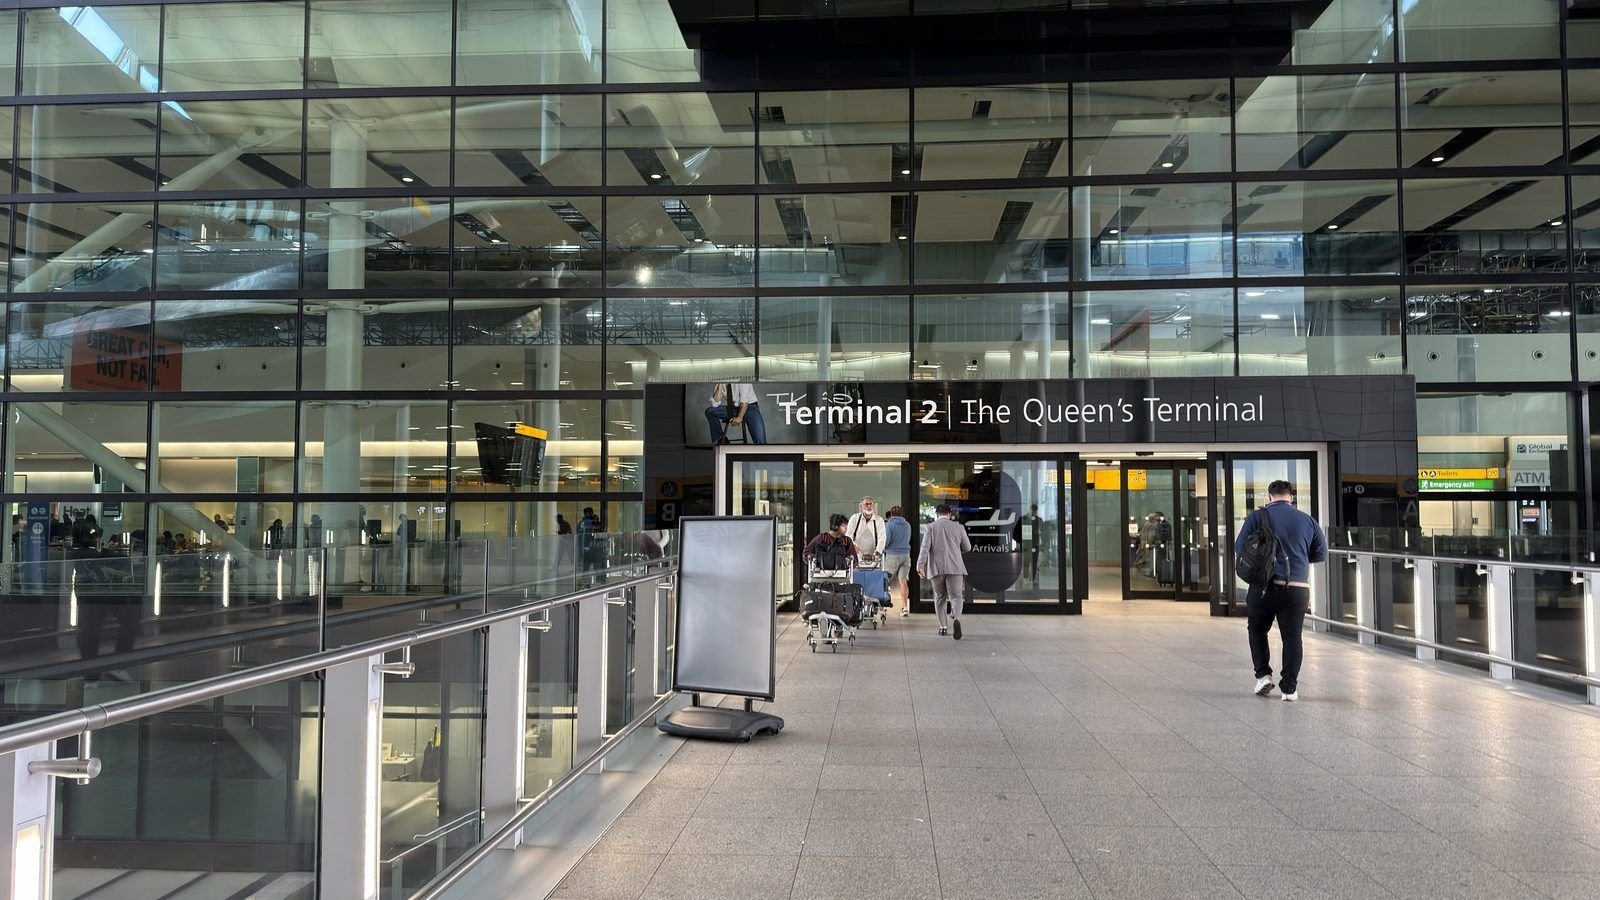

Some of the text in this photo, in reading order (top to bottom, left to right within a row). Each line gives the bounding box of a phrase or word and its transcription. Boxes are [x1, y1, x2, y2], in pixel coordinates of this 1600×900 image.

[87, 331, 135, 357] GREAT
[96, 354, 127, 379] NOT
[778, 395, 1263, 427] Terminal 2 The Queen’s Terminal
[1429, 481, 1461, 489] Emergency
[1514, 472, 1545, 484] ATM
[972, 543, 1010, 553] Arrivals
